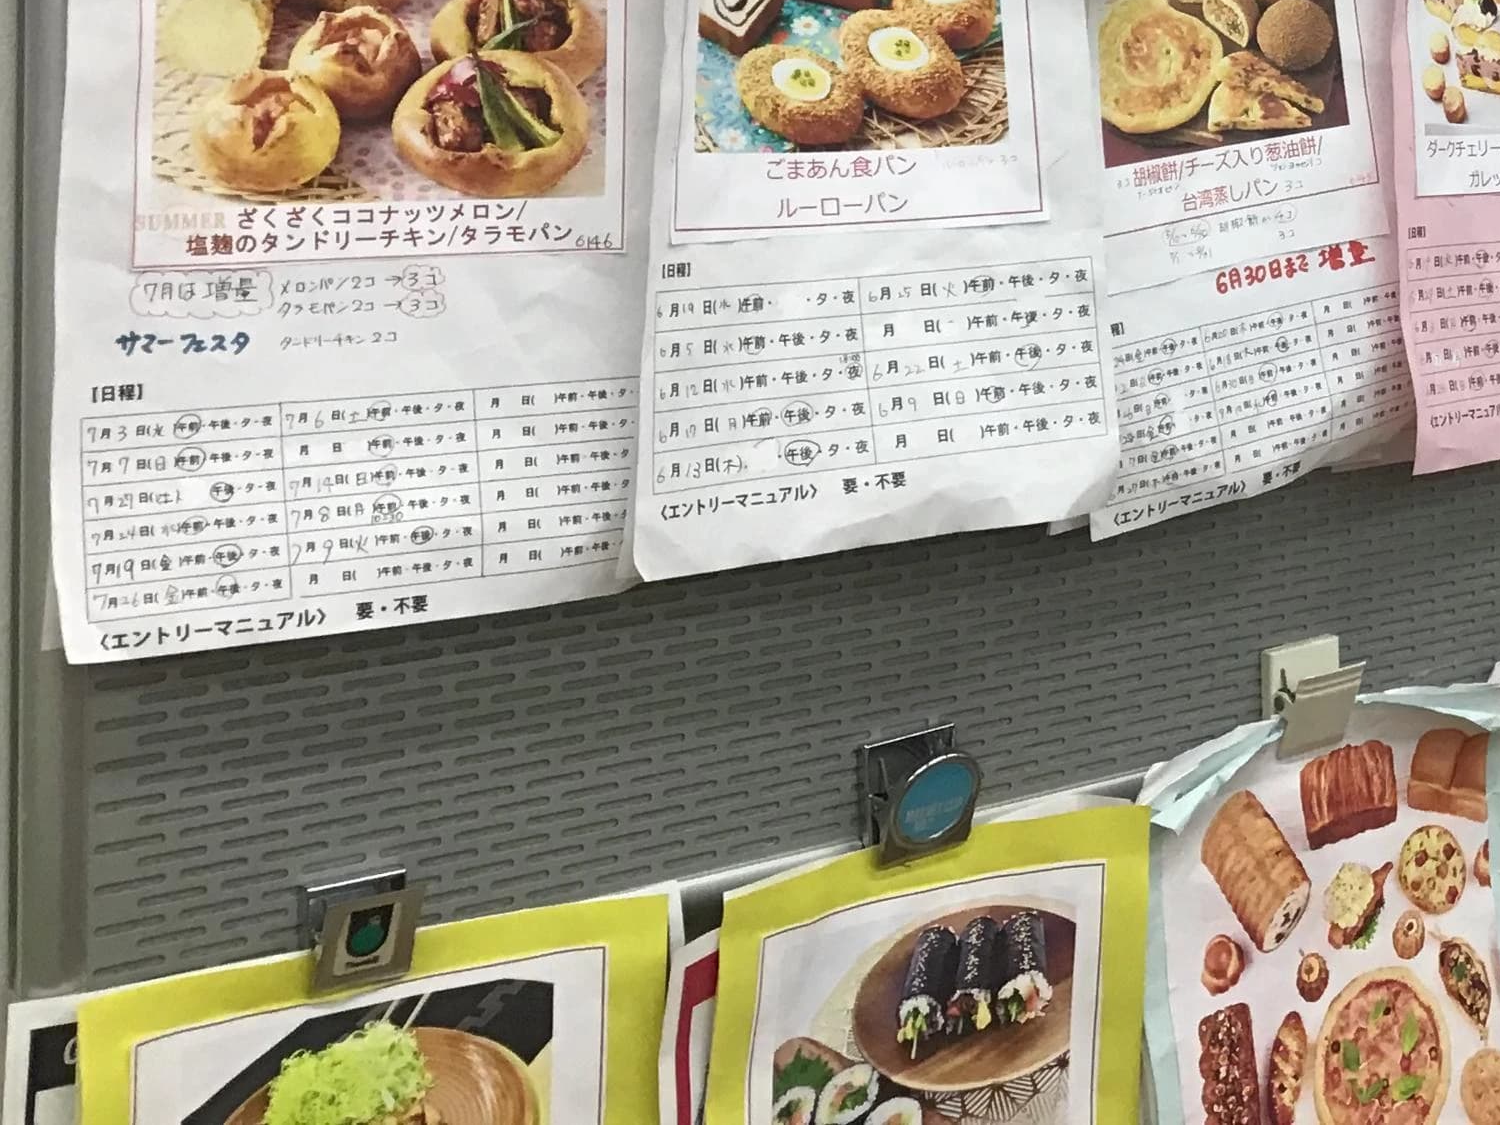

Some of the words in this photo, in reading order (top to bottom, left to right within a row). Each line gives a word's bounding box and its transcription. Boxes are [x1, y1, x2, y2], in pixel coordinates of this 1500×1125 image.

[766, 156, 918, 182] ごまあん食パン
[1133, 135, 1324, 187] 胡椒餅/チーズ入り葱油餅/
[776, 193, 909, 220] ルーローパン
[1181, 179, 1279, 213] 台湾蒸しパン
[237, 200, 529, 231] ざくざくココナッツメロン/
[186, 222, 572, 257] 塩麹のタンドリーチキン/タラモパン
[1215, 253, 1310, 296] 6月30日まで
[89, 385, 145, 405] 【日程】
[842, 471, 907, 496] 要・不要
[355, 595, 429, 621] 要・不要
